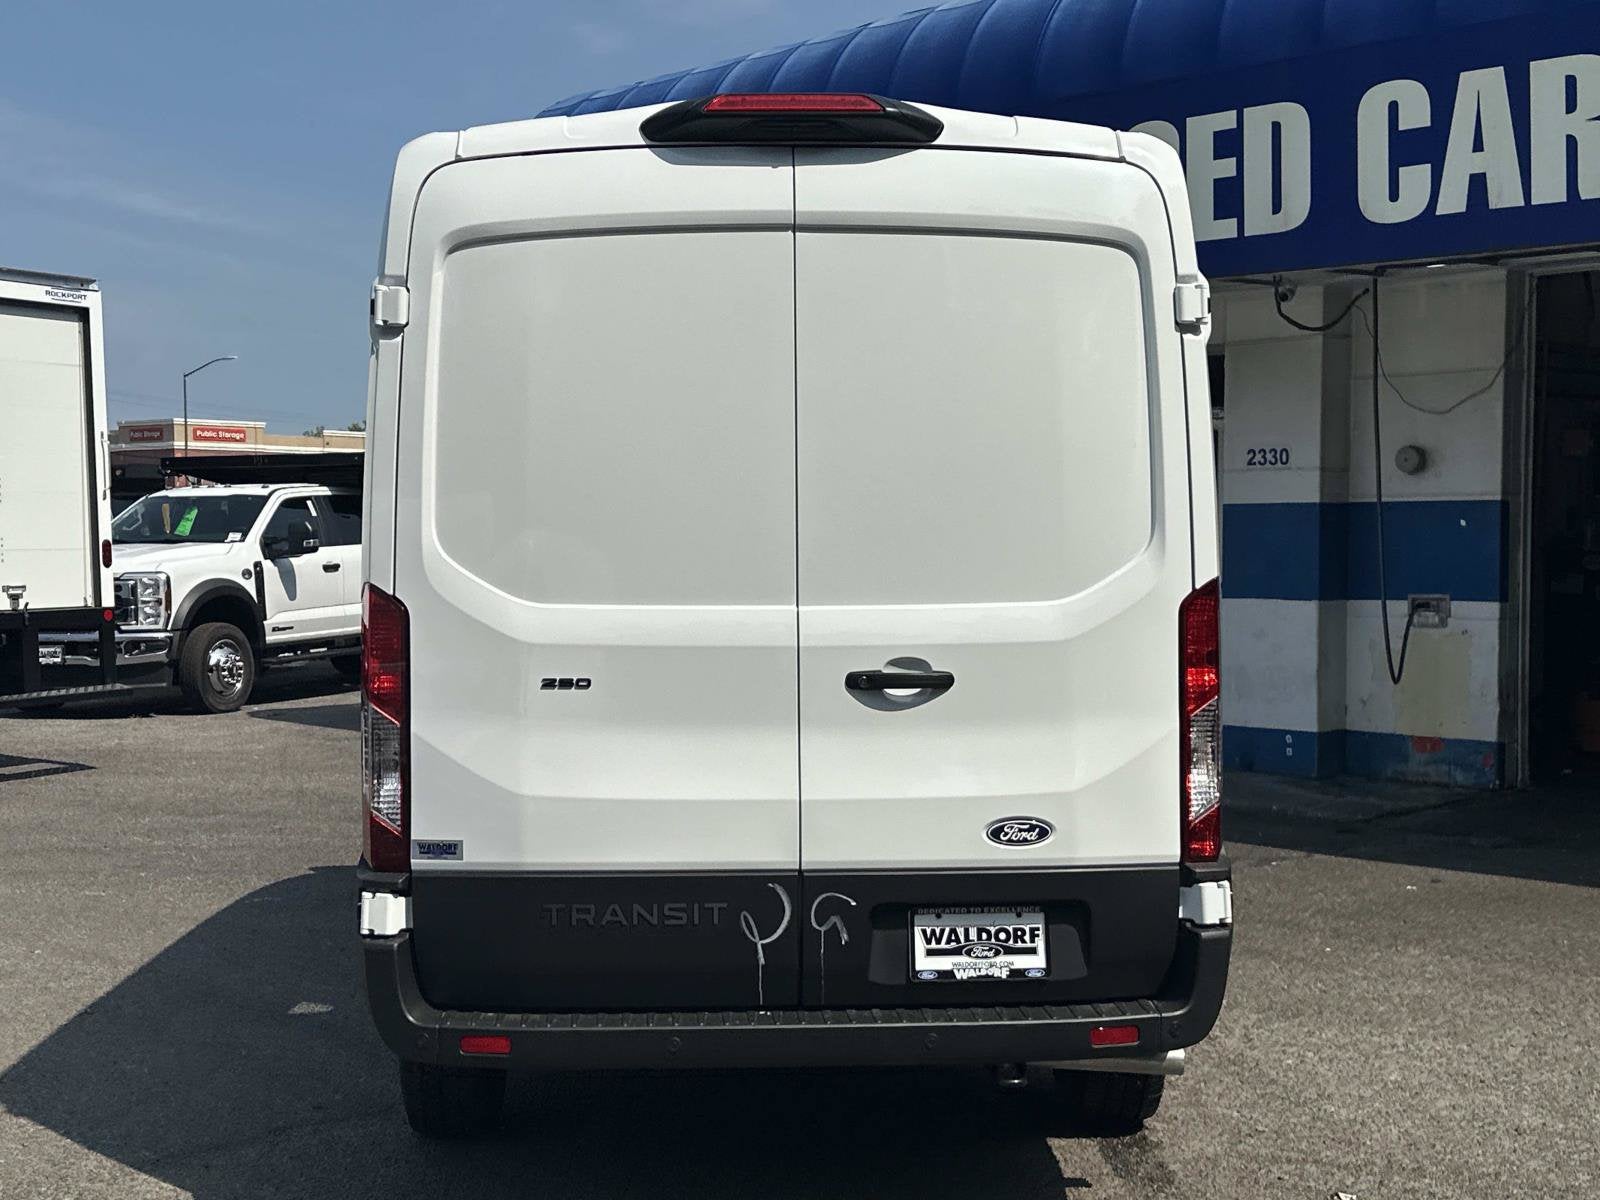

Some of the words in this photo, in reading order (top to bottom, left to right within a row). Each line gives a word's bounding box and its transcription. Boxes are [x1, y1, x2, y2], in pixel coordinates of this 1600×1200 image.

[1357, 54, 1600, 224] CAR
[45, 290, 87, 300] ROCKPORT
[196, 430, 218, 438] Public
[218, 430, 245, 440] Storage
[1247, 448, 1290, 466] 2330
[1000, 824, 1040, 841] Ford
[417, 842, 459, 851] WALDORF
[543, 902, 729, 926] TRANSIT
[920, 926, 1041, 946] WALDORF
[970, 946, 995, 958] Ford
[952, 967, 1010, 980] WALDORF
